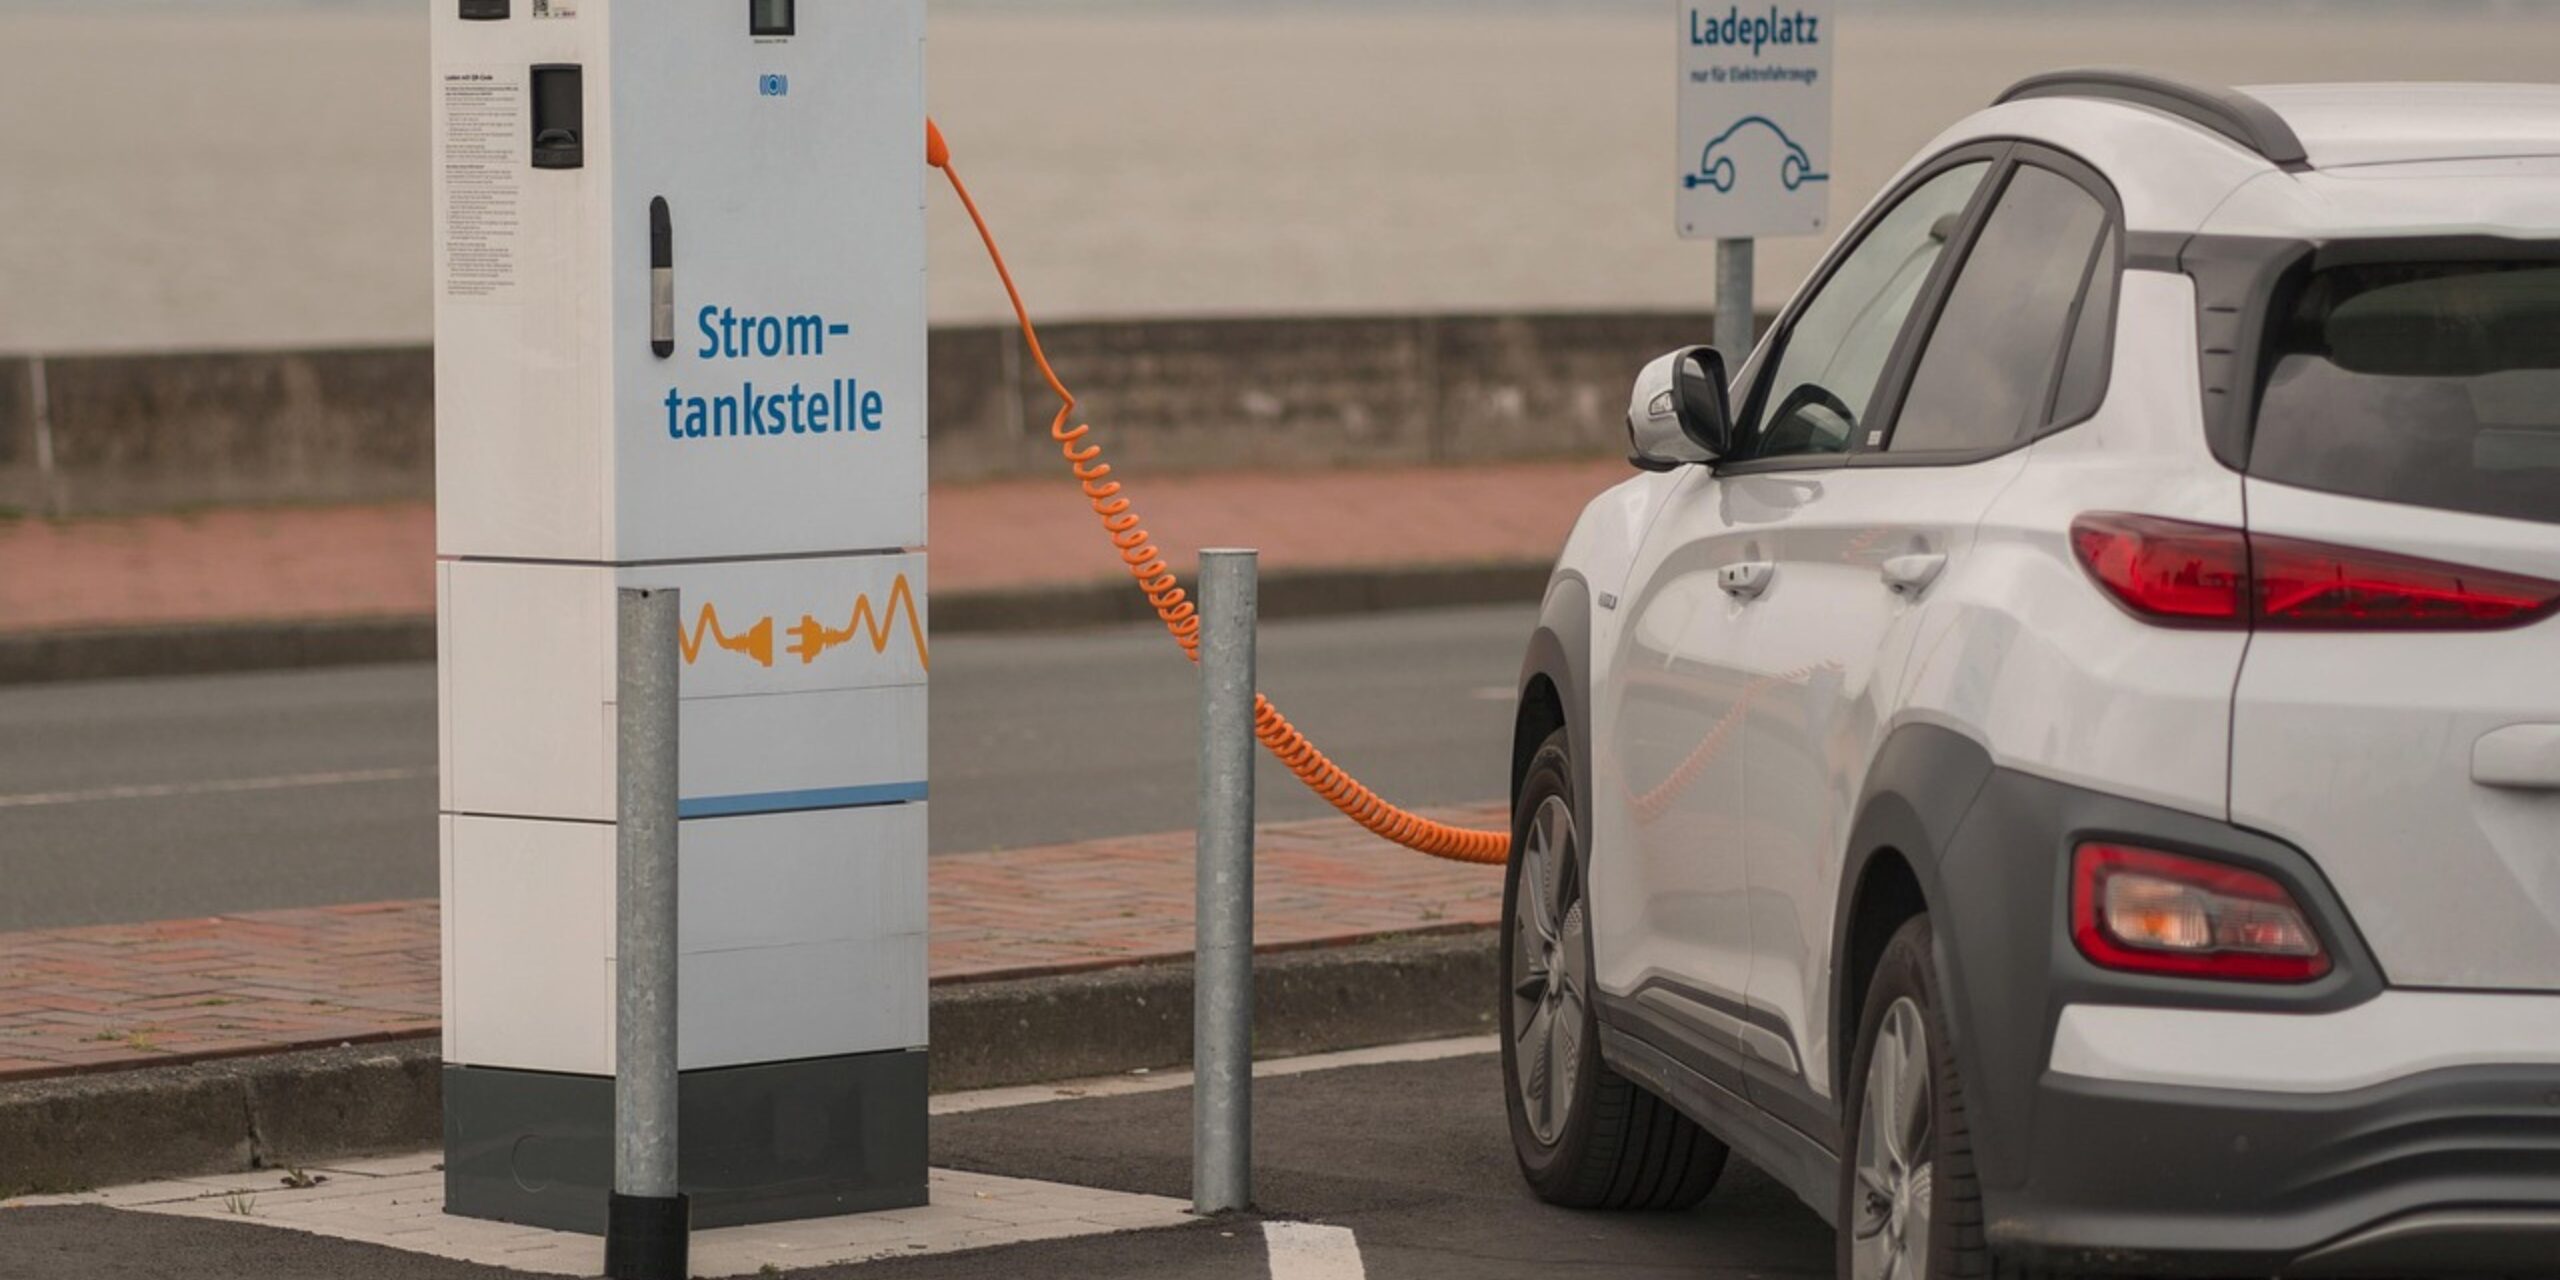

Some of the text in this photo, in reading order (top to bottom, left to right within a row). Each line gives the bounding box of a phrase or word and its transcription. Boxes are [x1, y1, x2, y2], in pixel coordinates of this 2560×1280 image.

[1691, 5, 1818, 57] Ladeplatz
[1691, 66, 1817, 85] nur für Elektrofahrzeuge
[698, 305, 849, 359] Strom-
[664, 378, 883, 439] tankstelle
